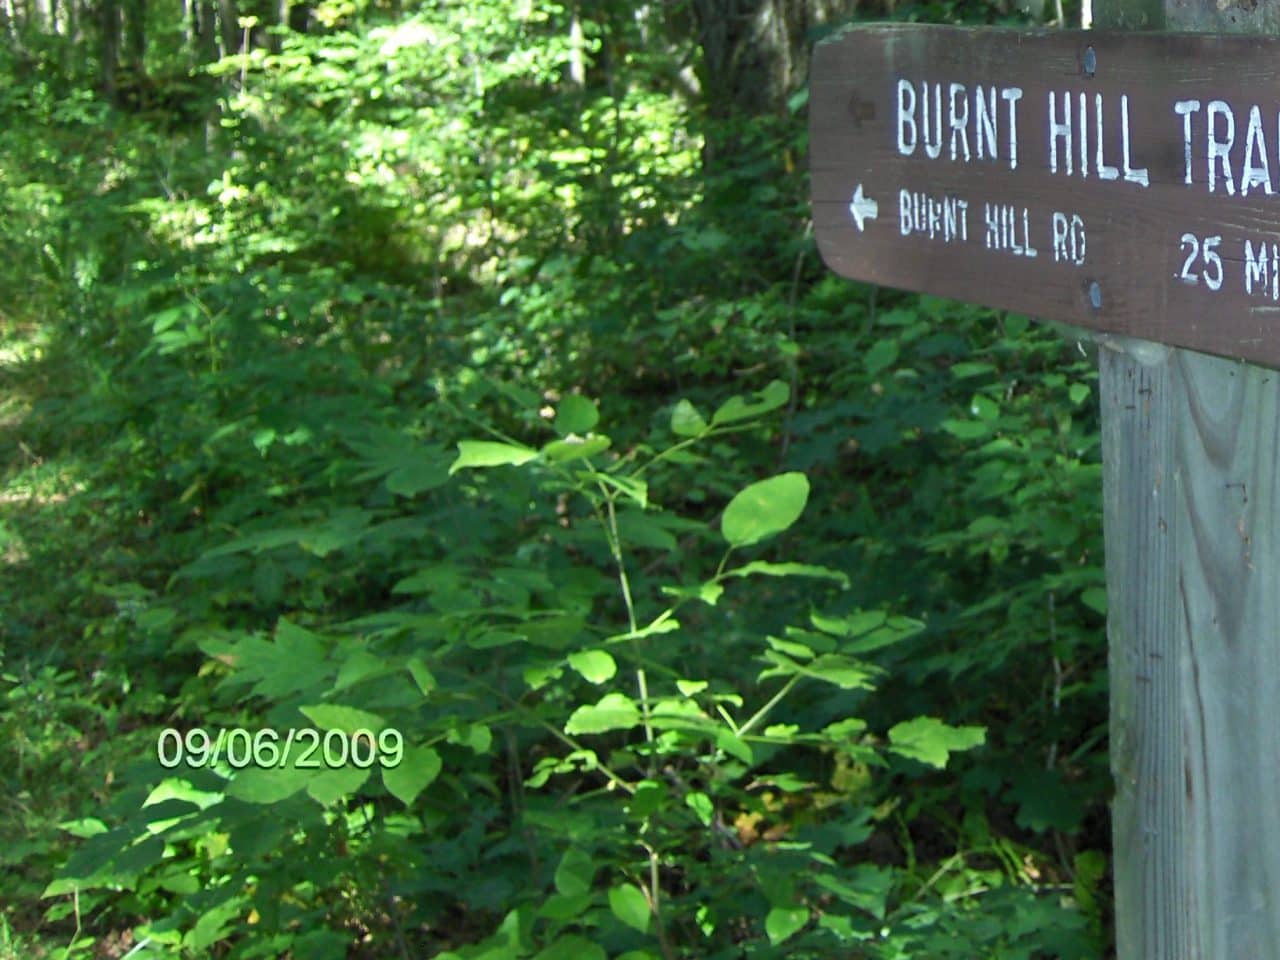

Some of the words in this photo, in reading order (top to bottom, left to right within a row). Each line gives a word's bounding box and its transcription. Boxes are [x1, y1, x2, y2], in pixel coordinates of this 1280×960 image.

[897, 78, 1024, 171] BURNT
[1049, 90, 1150, 188] HILL
[899, 188, 968, 243] BURNT
[985, 201, 1038, 258] HILL
[1052, 211, 1087, 265] RD
